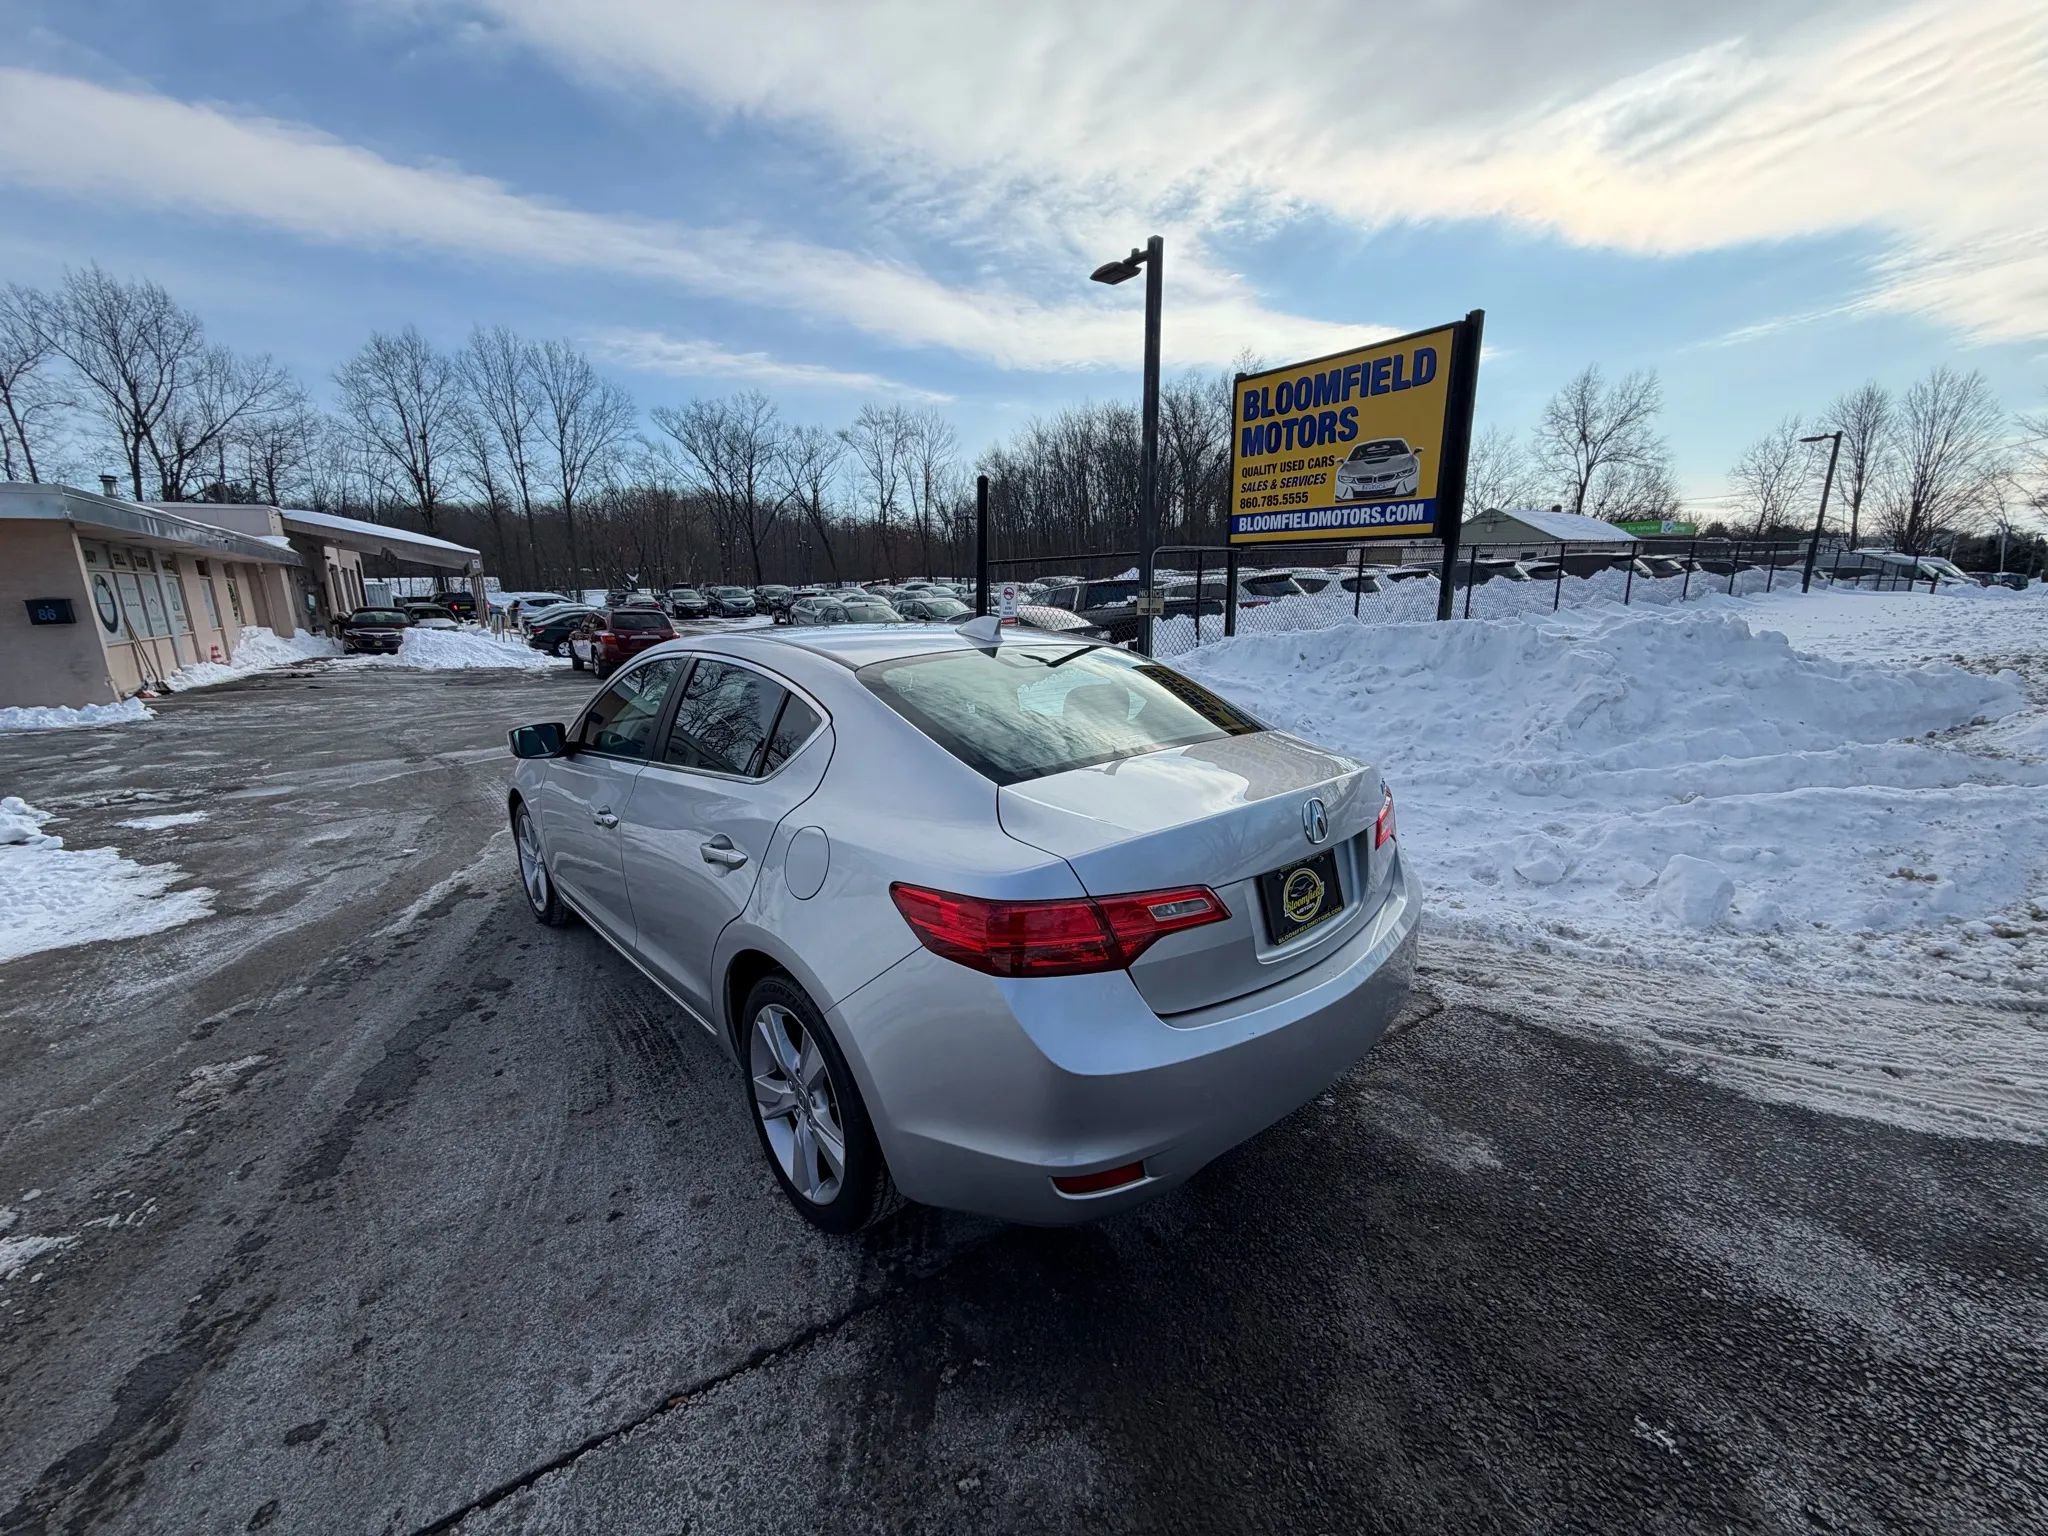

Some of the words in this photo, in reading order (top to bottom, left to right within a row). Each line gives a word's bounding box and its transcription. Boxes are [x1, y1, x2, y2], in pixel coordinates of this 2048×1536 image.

[1243, 347, 1437, 422] BLOOMFIELD
[1241, 406, 1359, 458] MOTORS
[1241, 463, 1278, 478] QUALITY
[1280, 460, 1305, 473] USED
[1308, 455, 1335, 469] CARS
[1240, 479, 1268, 493] SALES
[1270, 478, 1278, 490] &
[1279, 473, 1328, 488] SERVICES
[1240, 491, 1309, 509] 860.785.5555
[1239, 503, 1425, 532] BLOOMFIELDMOTORS.COM
[1138, 589, 1163, 598] NOICE
[38, 608, 57, 620] 86
